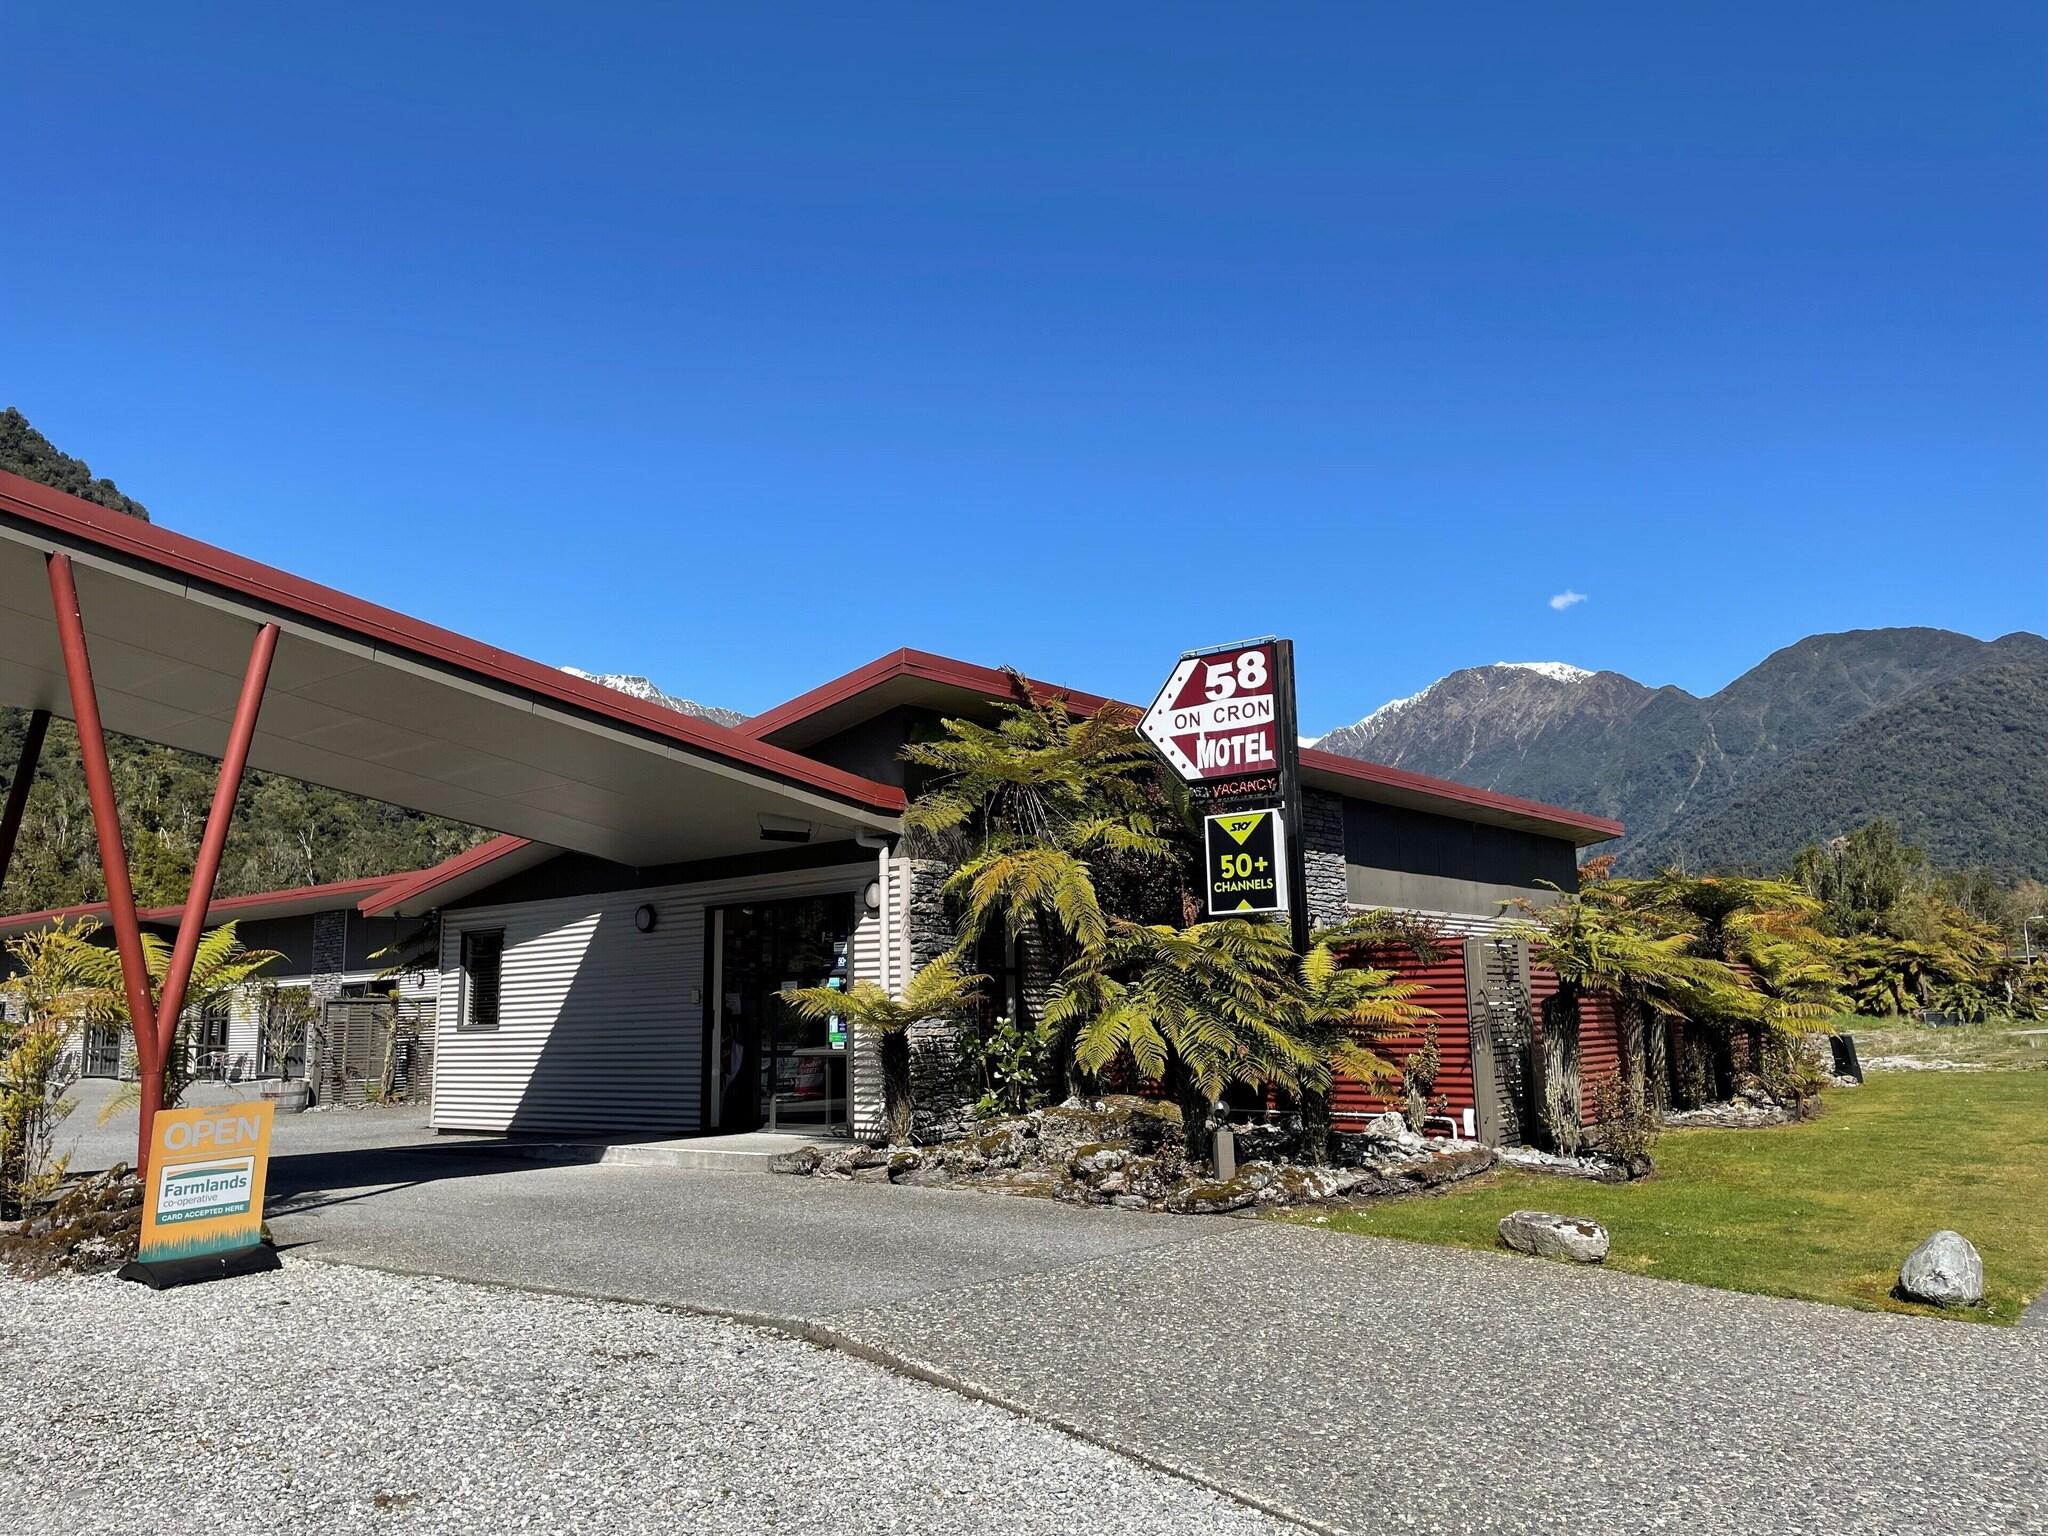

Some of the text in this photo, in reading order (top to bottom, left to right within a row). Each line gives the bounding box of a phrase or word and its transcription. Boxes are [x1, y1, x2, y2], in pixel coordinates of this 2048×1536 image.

[1201, 650, 1268, 701] 58
[1174, 700, 1270, 730] ON CRON
[1195, 731, 1275, 769] MOTEL
[1212, 778, 1277, 798] VACANCY
[1230, 820, 1252, 832] SKY
[1221, 853, 1268, 879] 50+
[1214, 878, 1274, 893] CHANNELS
[164, 1116, 260, 1150] OPEN
[165, 1176, 247, 1197] Farmlands
[163, 1193, 218, 1208] co-operative
[162, 1204, 244, 1222] CARD ACCEPTED HERE
